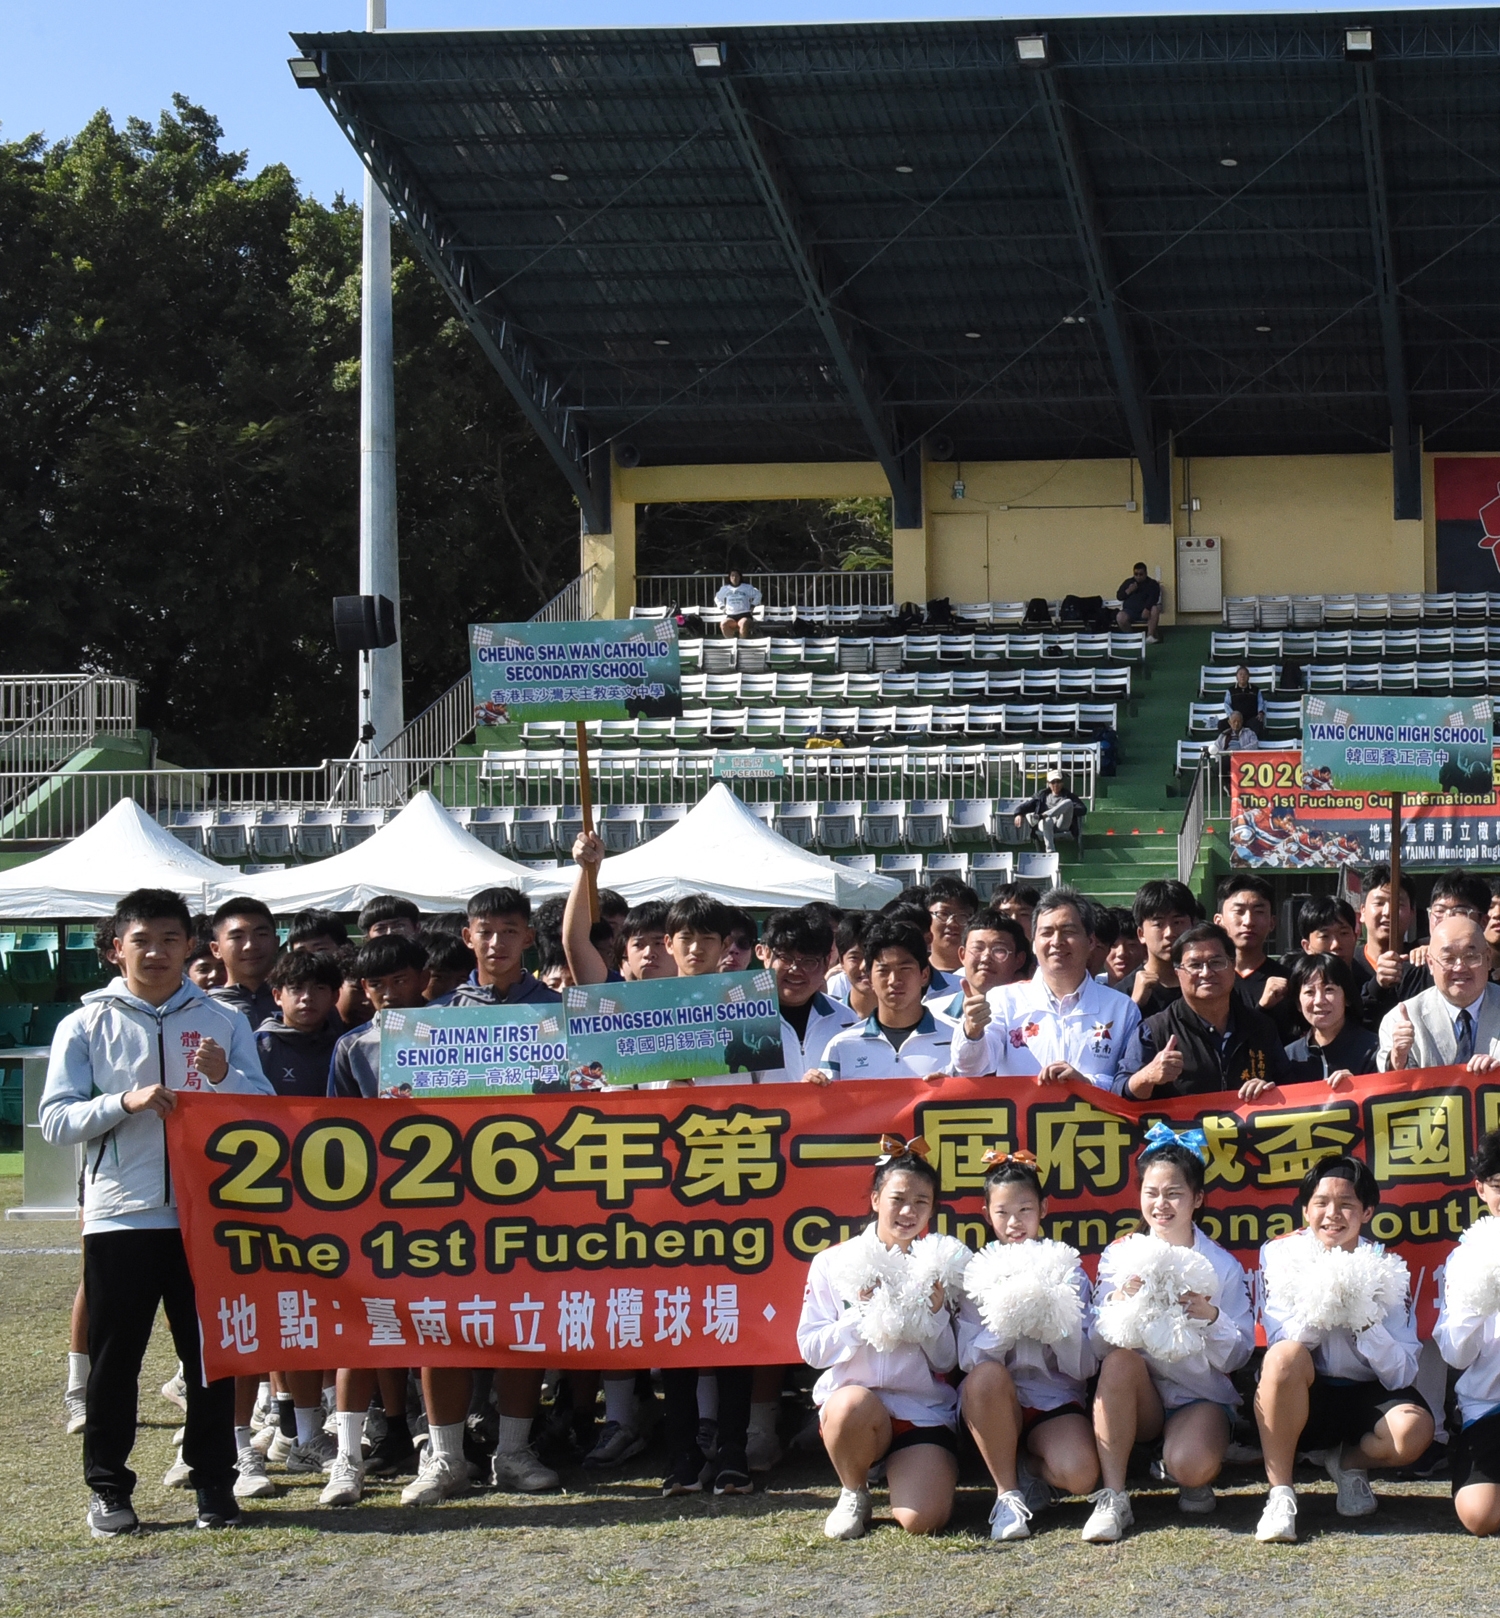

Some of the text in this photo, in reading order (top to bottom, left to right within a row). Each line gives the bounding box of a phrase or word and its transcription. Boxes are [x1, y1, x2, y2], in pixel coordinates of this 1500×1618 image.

[478, 641, 668, 662] CHEUNG SHA WAN CATHOLIC
[505, 662, 648, 682] SECONDARY SCHOOL
[492, 683, 665, 704] 香港長沙灣天主教英文中學
[1309, 724, 1487, 744] YANG CHUNG HIGH SCHOOL
[1346, 748, 1449, 766] 韓國養正高中
[721, 769, 776, 778] VIP SEATING
[1240, 794, 1270, 808] The
[1273, 794, 1296, 808] 1st
[1299, 794, 1363, 810] Fucheng
[1367, 793, 1393, 810] Cup
[1402, 791, 1495, 806] International
[1369, 846, 1392, 861] Venu
[1405, 846, 1436, 860] TAINAN
[1438, 844, 1479, 861] Municipal
[569, 999, 777, 1036] MYEONGSEOK HIGH SCHOOL
[429, 1024, 539, 1046] TAINAN FIRST
[617, 1027, 734, 1056] 韓國明錫高中
[397, 1046, 459, 1067] SENIOR
[462, 1045, 504, 1065] HIGH
[413, 1065, 559, 1089] 臺南第一高級中學
[223, 1229, 341, 1272] The
[370, 1228, 467, 1270] 1st
[494, 1221, 766, 1266] Fucheng
[1370, 1195, 1491, 1241] outh
